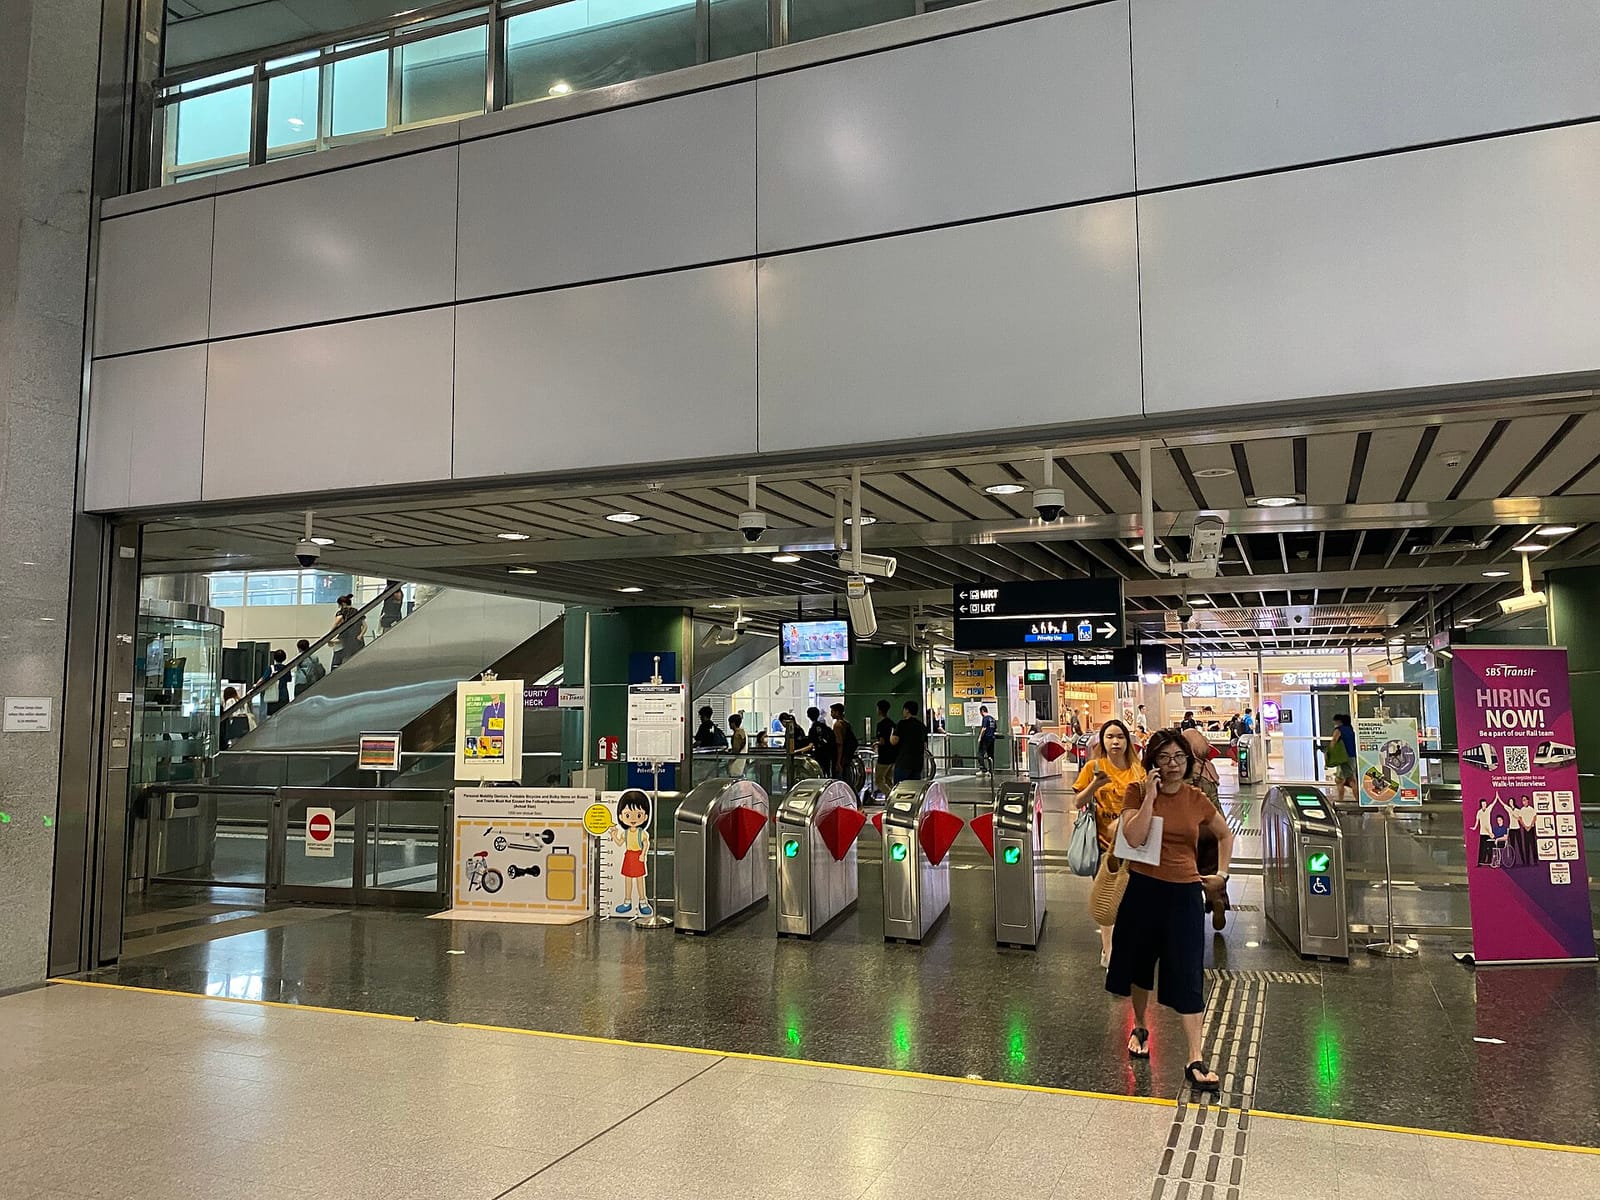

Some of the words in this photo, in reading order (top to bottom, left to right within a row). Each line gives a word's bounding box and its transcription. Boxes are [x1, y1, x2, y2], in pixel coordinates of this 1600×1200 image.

[980, 589, 999, 599] MRT
[980, 603, 996, 612] LRT
[1485, 667, 1501, 677] SBS
[1500, 664, 1537, 678] Transit
[523, 690, 548, 698] CURITY
[1476, 688, 1551, 708] HIRING
[1485, 709, 1545, 729] NOW!
[1493, 730, 1507, 738] part
